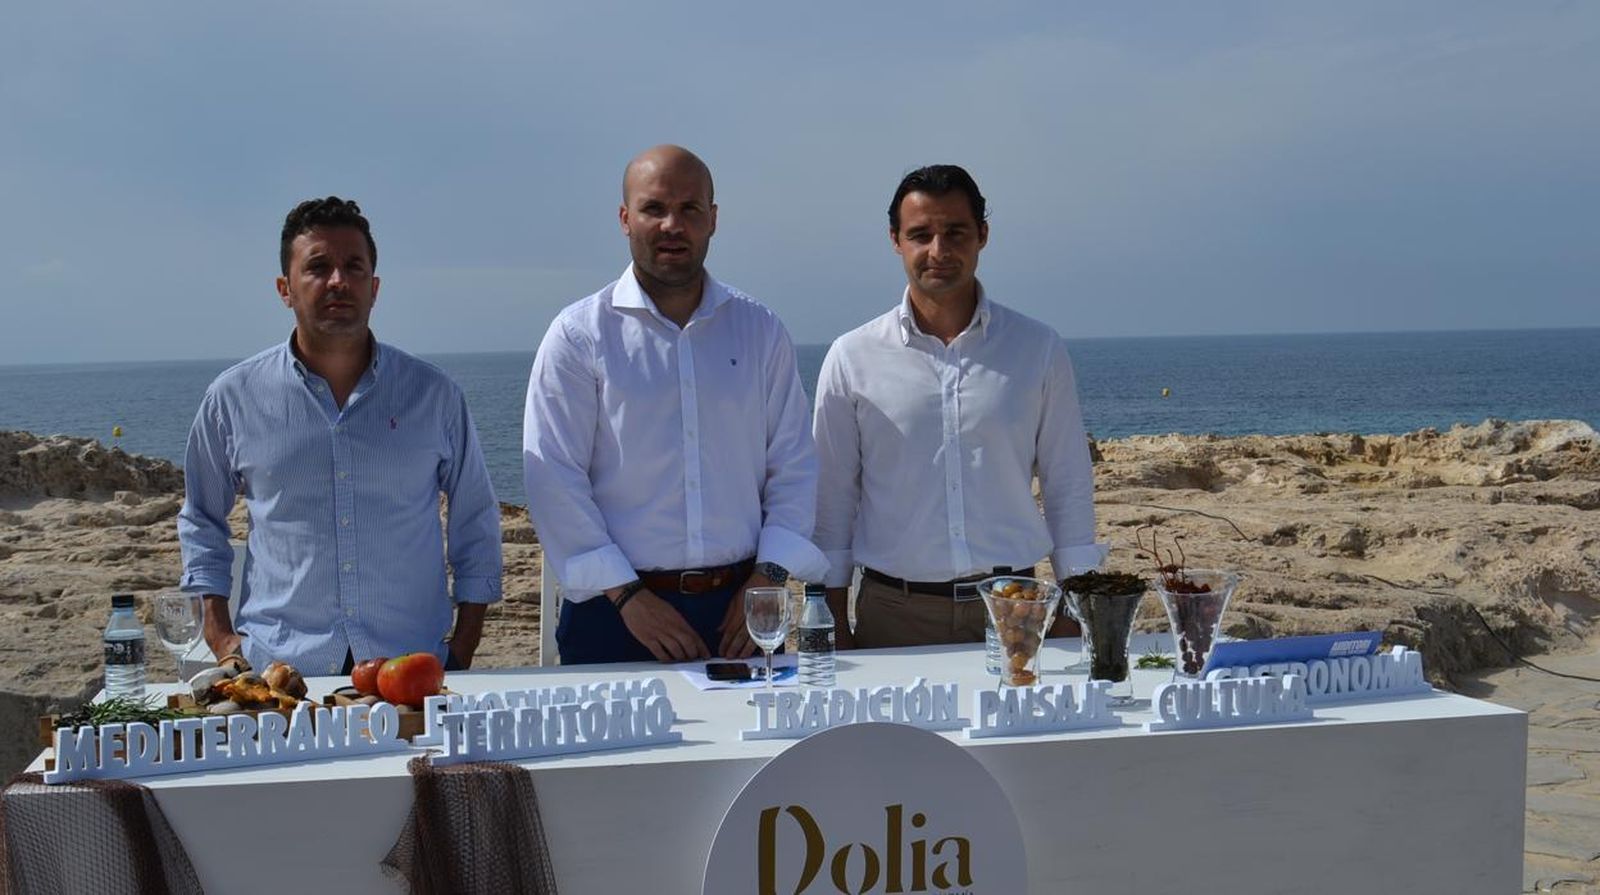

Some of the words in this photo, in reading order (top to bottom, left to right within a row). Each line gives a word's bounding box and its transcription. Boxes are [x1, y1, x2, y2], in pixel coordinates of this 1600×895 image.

[1205, 645, 1424, 694] RONOMÍA
[750, 676, 959, 729] TRADICIÓN
[974, 680, 1114, 728] PAISAJE
[1152, 674, 1306, 721] CULTURA
[54, 701, 400, 772] MEDITERRÁNEO
[437, 695, 673, 755] TERRITORIO
[758, 804, 974, 895] Dolia
